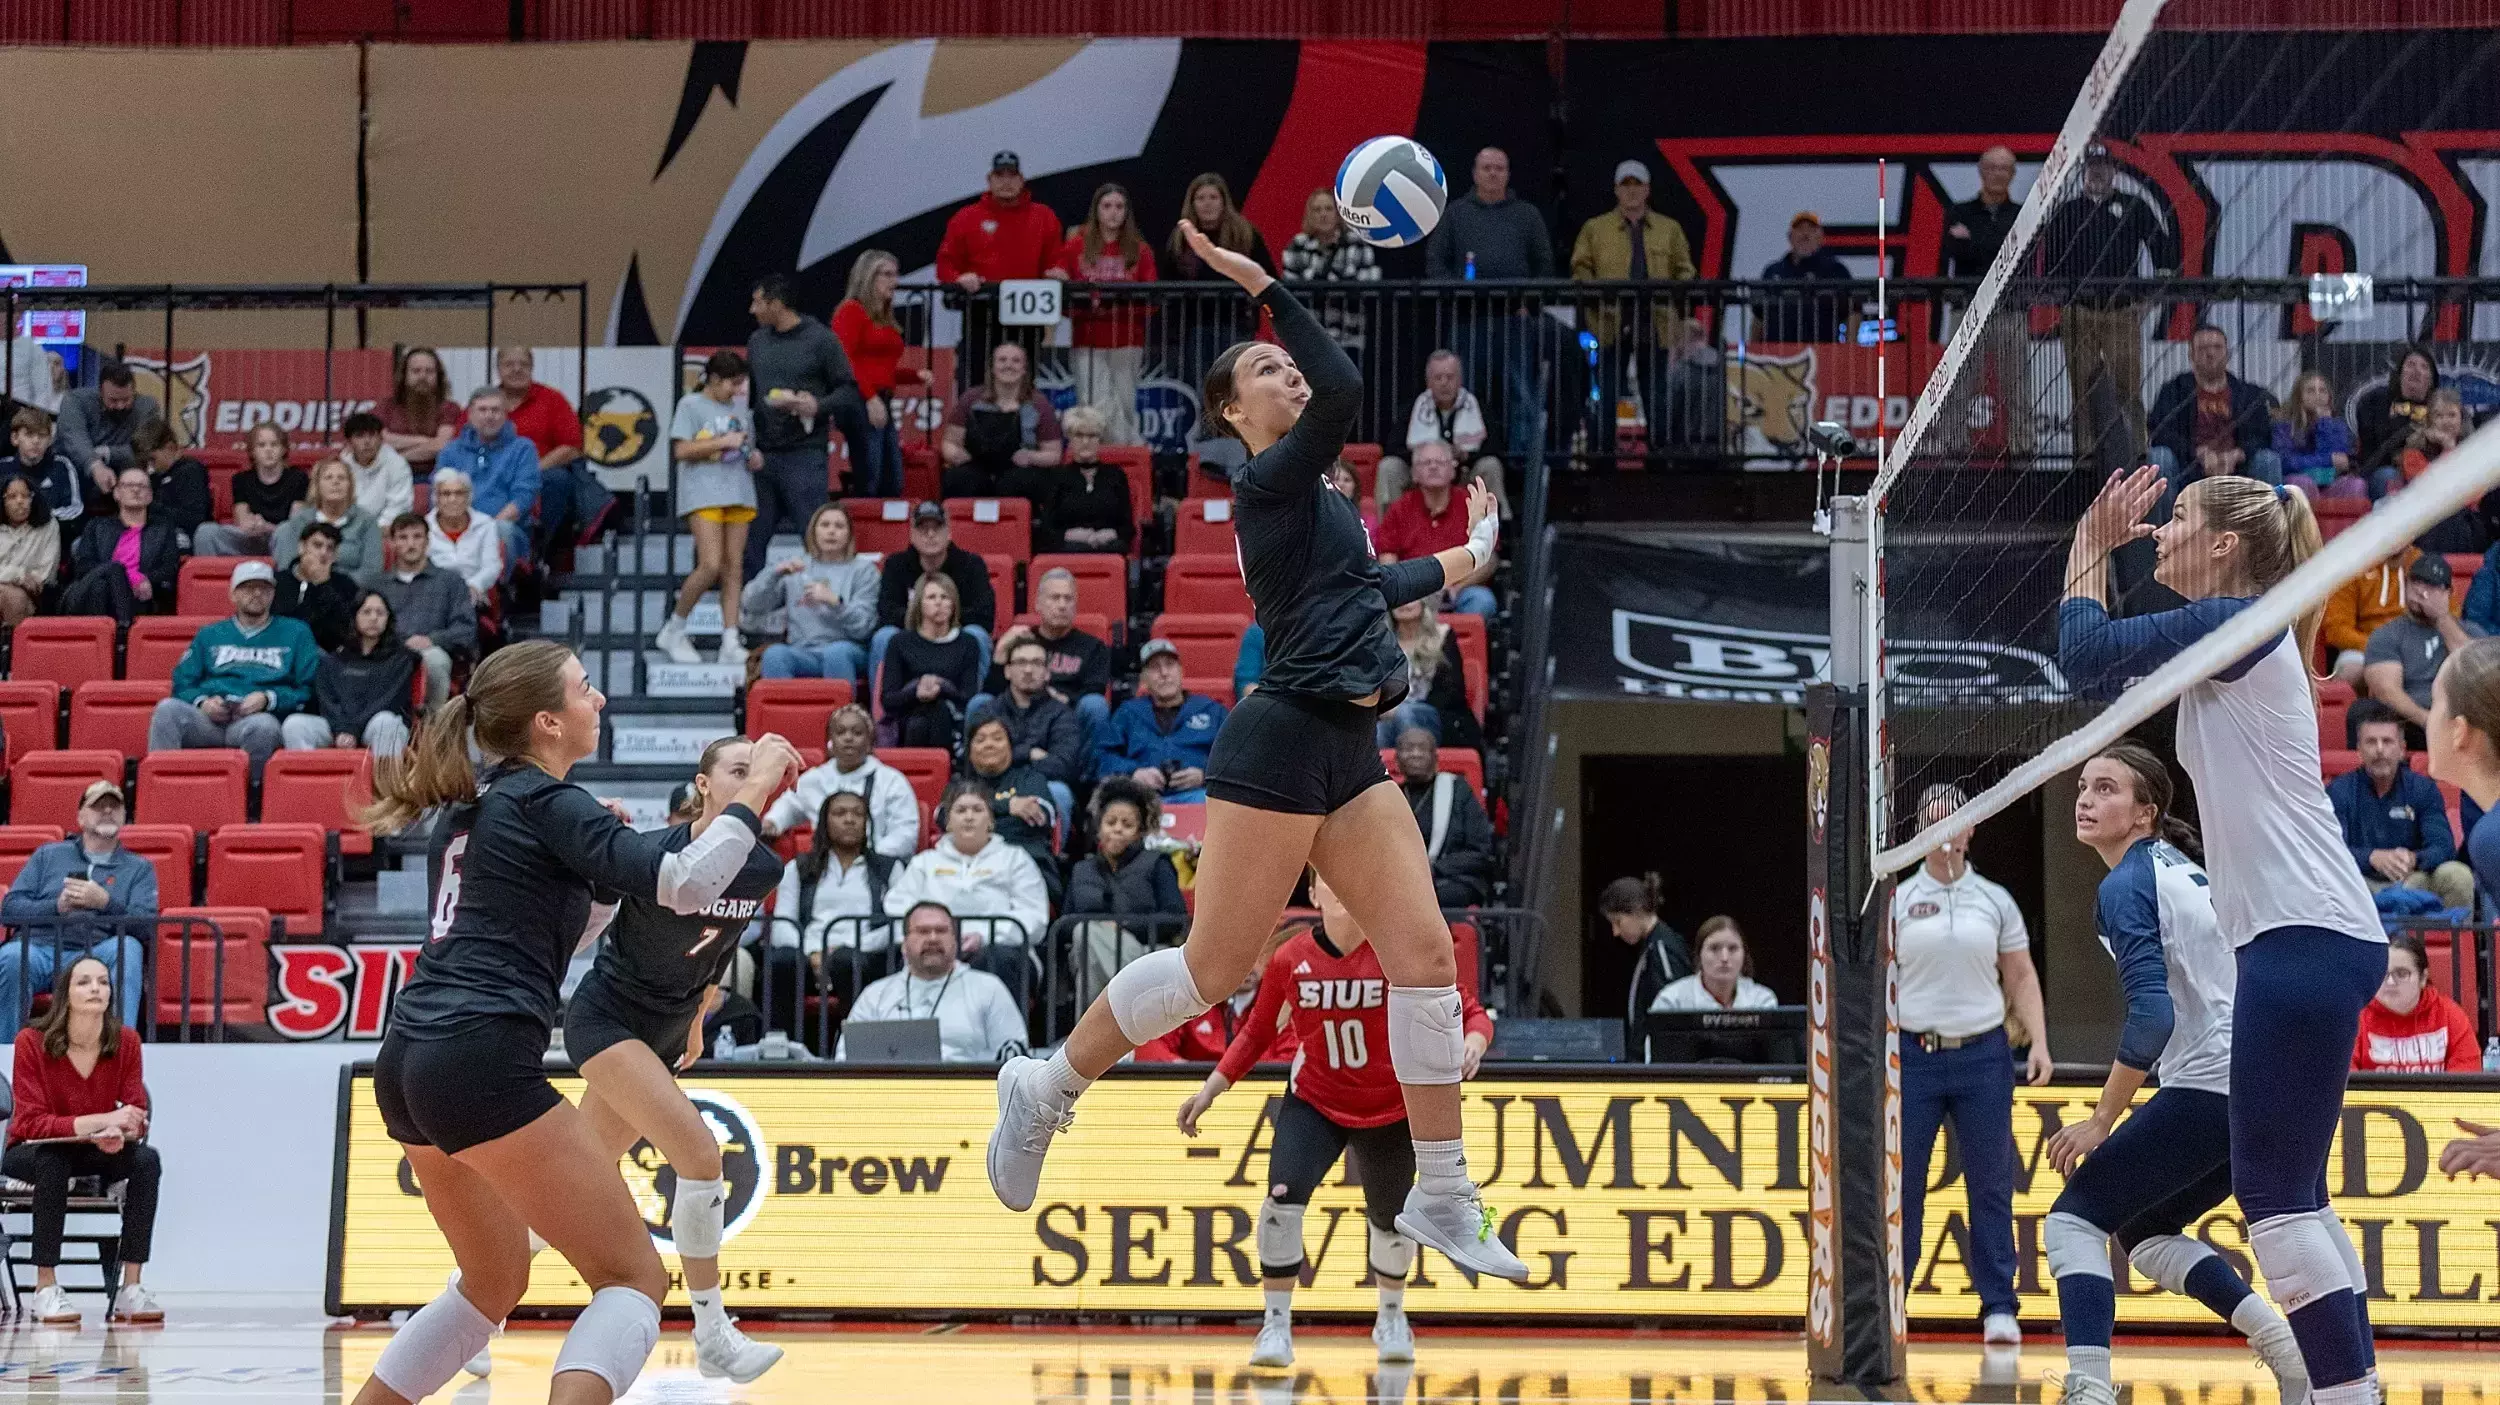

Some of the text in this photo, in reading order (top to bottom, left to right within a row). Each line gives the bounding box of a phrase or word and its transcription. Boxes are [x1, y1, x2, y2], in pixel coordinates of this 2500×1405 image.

[1339, 205, 1372, 225] olten
[1005, 291, 1055, 315] 103
[431, 831, 469, 943] 6
[686, 926, 721, 956] 7
[268, 944, 424, 1039] SI
[1298, 978, 1384, 1010] SIUE
[1323, 1018, 1368, 1070] 10
[2368, 1026, 2448, 1064] SIUE
[1809, 888, 1833, 1348] COUGARS
[776, 1145, 951, 1195] Brew
